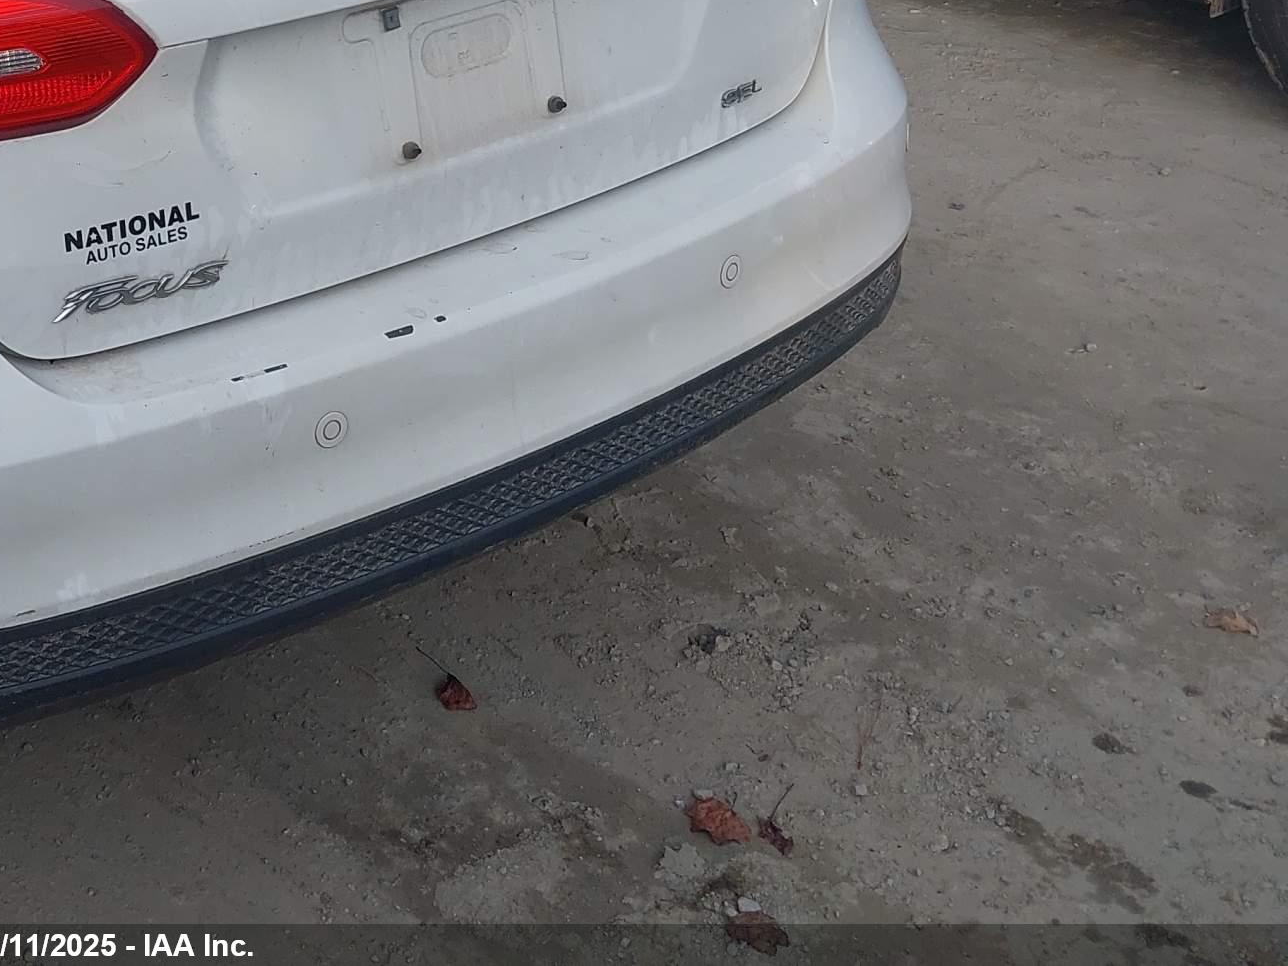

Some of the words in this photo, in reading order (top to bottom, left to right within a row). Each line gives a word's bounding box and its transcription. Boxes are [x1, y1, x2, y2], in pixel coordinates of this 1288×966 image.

[721, 79, 763, 108] SEL
[64, 202, 200, 252] NATIONAL
[86, 241, 132, 265] AUTO
[136, 226, 188, 252] SALES
